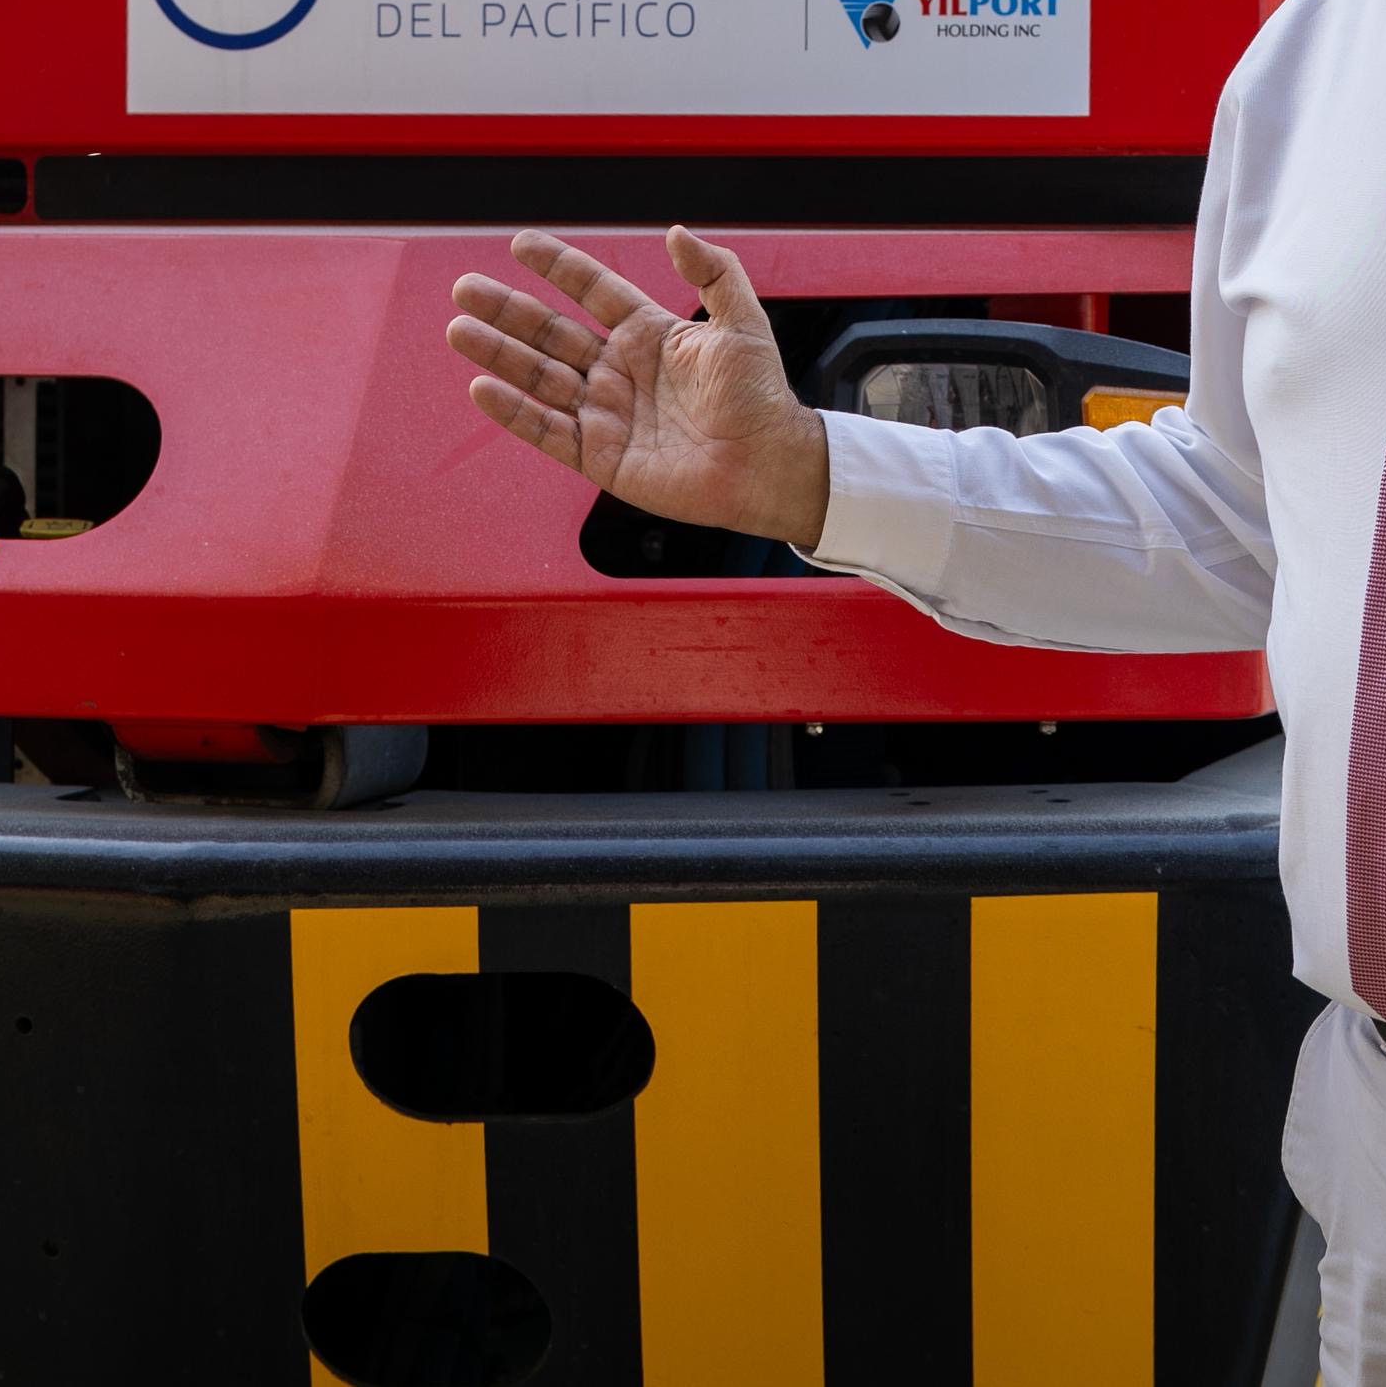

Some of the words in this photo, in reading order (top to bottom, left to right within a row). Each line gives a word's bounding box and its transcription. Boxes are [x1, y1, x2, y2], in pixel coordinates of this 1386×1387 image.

[376, 2, 462, 38] DEL
[936, 23, 1010, 38] HOLDING
[1013, 23, 1041, 38] INC
